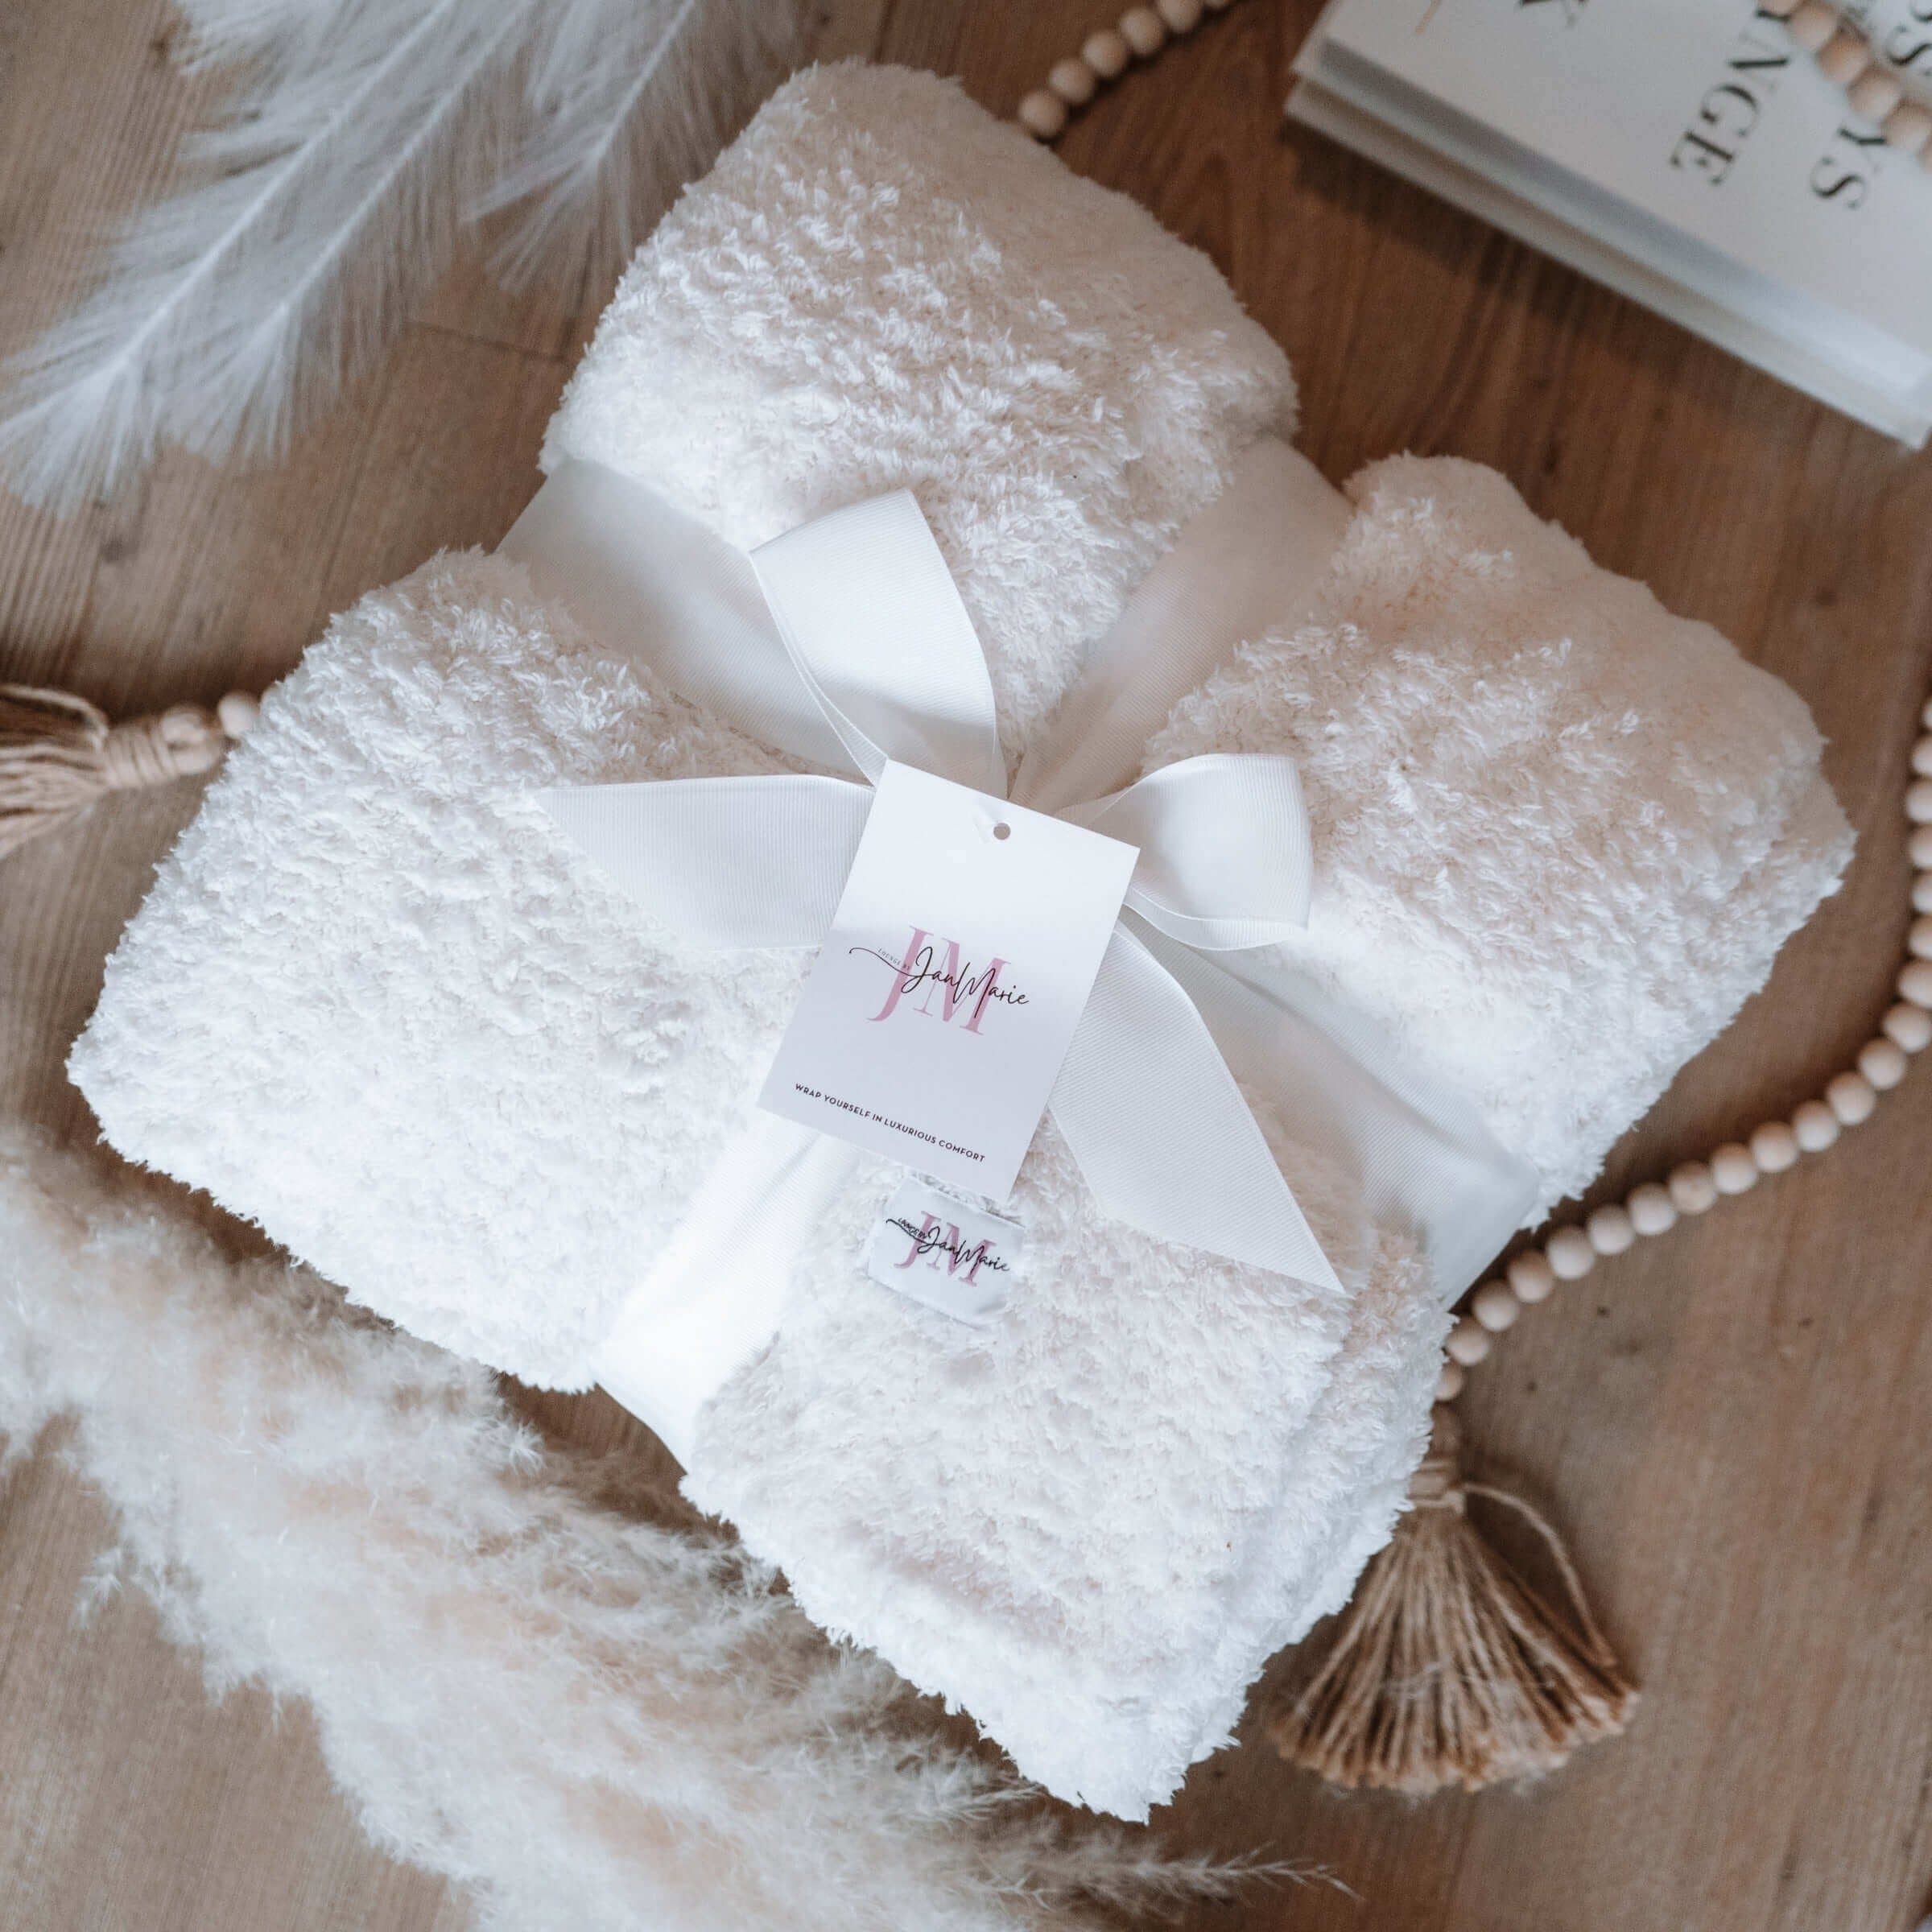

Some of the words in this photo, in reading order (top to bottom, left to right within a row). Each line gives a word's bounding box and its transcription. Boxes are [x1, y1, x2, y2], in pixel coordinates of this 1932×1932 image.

[866, 925, 1012, 1035] JM
[795, 1083, 821, 1098] WRAP
[824, 1095, 871, 1118] YOURSELF
[872, 1113, 882, 1123] IN
[884, 1118, 936, 1144] LUXURIOUS
[939, 1140, 985, 1162] COMFORT
[894, 1210, 997, 1287] JM
